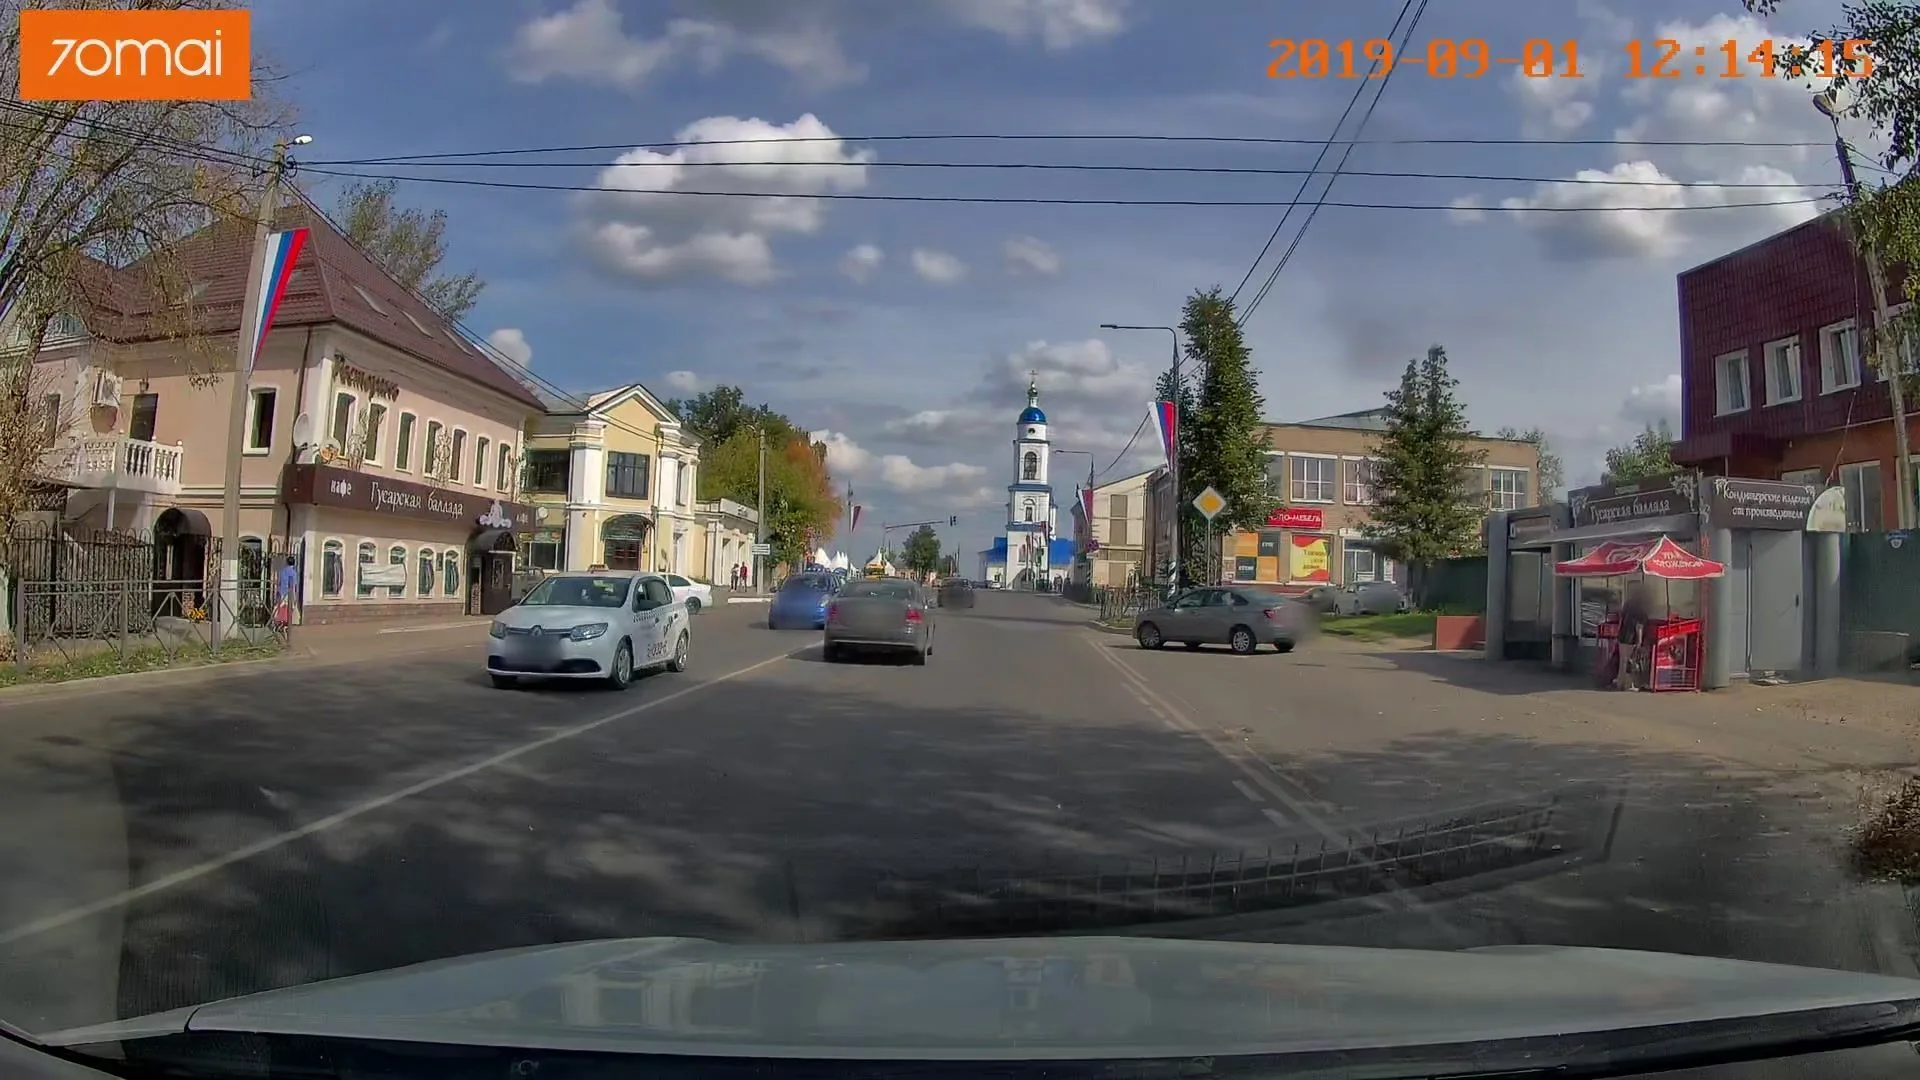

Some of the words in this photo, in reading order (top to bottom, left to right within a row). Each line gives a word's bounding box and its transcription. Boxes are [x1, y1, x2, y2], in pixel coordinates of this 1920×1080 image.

[330, 479, 352, 499] кафе
[370, 481, 422, 512] Гусарская
[427, 489, 464, 519] баллада
[1590, 504, 1632, 526] Гусарская
[1633, 497, 1671, 517] баллада
